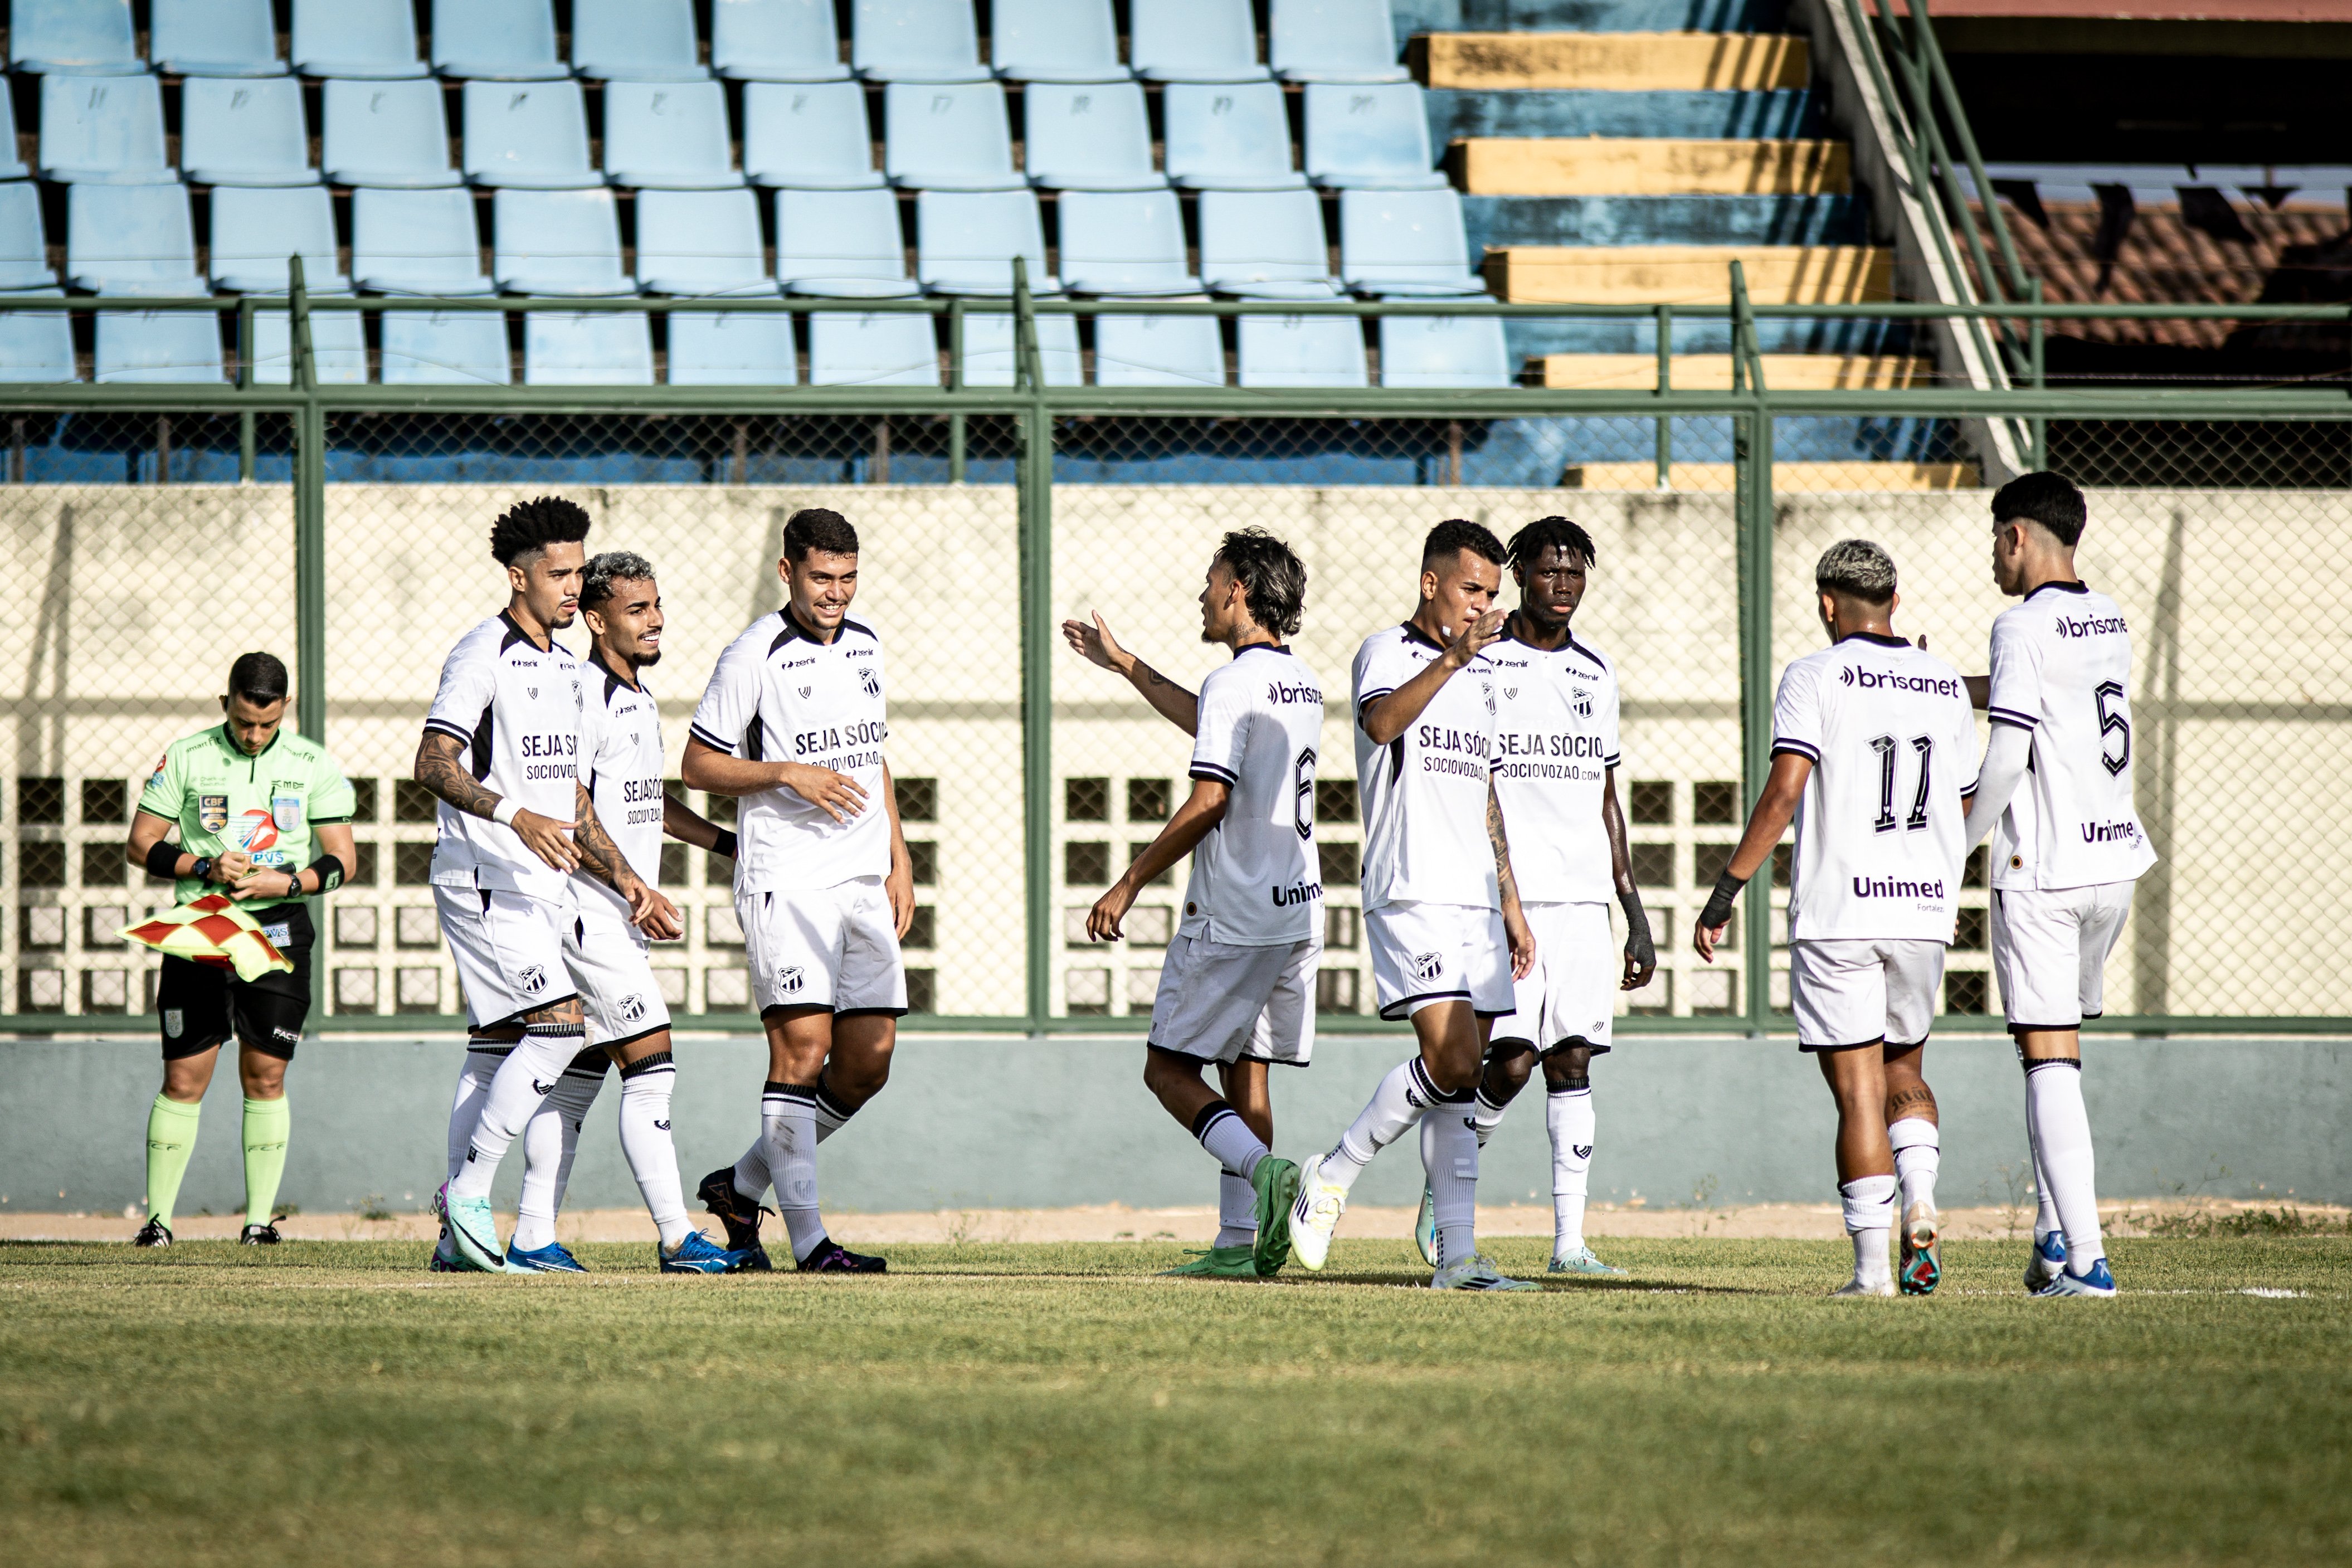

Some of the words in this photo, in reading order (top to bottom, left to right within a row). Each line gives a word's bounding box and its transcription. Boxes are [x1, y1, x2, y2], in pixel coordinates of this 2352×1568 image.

[795, 656, 816, 668] zenir
[1578, 671, 1599, 681] zenir
[1857, 665, 1959, 699] brisanet
[1419, 725, 1462, 752] SEJA
[2092, 677, 2130, 780] 5
[522, 734, 563, 757] SEJA
[796, 728, 841, 755] SEJA
[1499, 733, 1545, 756] SEJA
[1551, 733, 1604, 758] SÓCIO
[1502, 763, 1600, 781] SOCIOVOZAO.COM
[624, 780, 649, 803] SEJA
[1293, 744, 1317, 845] 6
[1864, 732, 1935, 837] 11
[204, 797, 224, 807] CBF
[2081, 819, 2134, 844] Unime
[252, 851, 284, 864] PVS
[1853, 875, 1944, 900] Unimed
[1917, 903, 1944, 913] Fortalez
[263, 927, 288, 937] PVS
